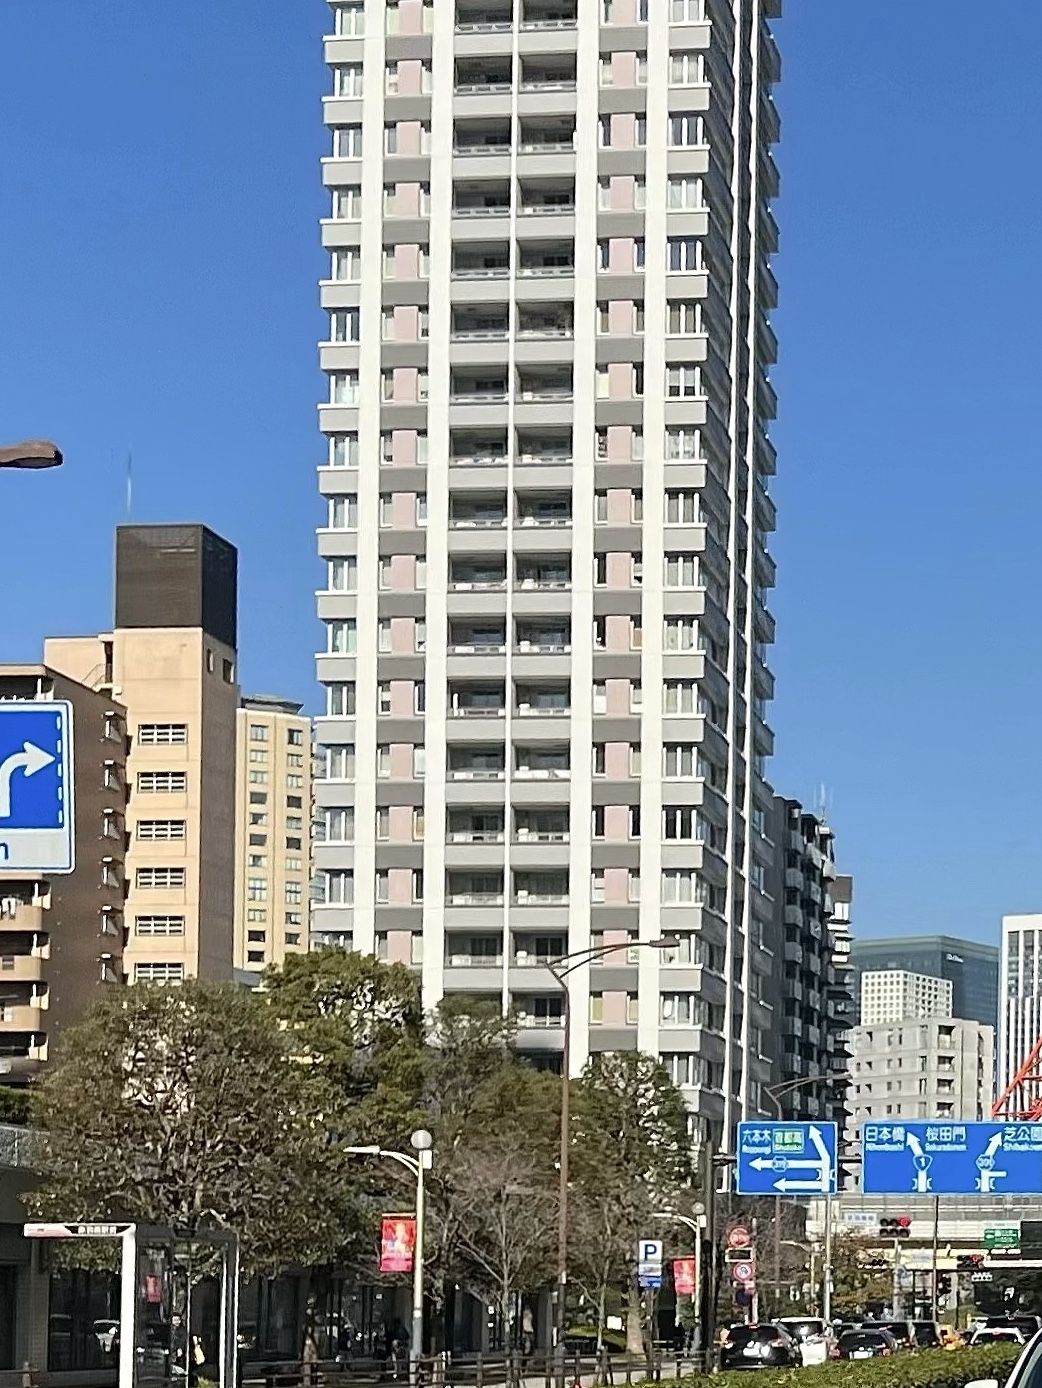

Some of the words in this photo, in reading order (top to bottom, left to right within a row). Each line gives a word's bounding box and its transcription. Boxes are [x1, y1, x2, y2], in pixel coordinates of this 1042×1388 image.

[742, 1129, 771, 1144] 六本木
[926, 1126, 966, 1142] 桜田門
[1003, 1126, 1042, 1142] 芝公園
[919, 1157, 925, 1168] 1
[644, 1244, 657, 1260] P
